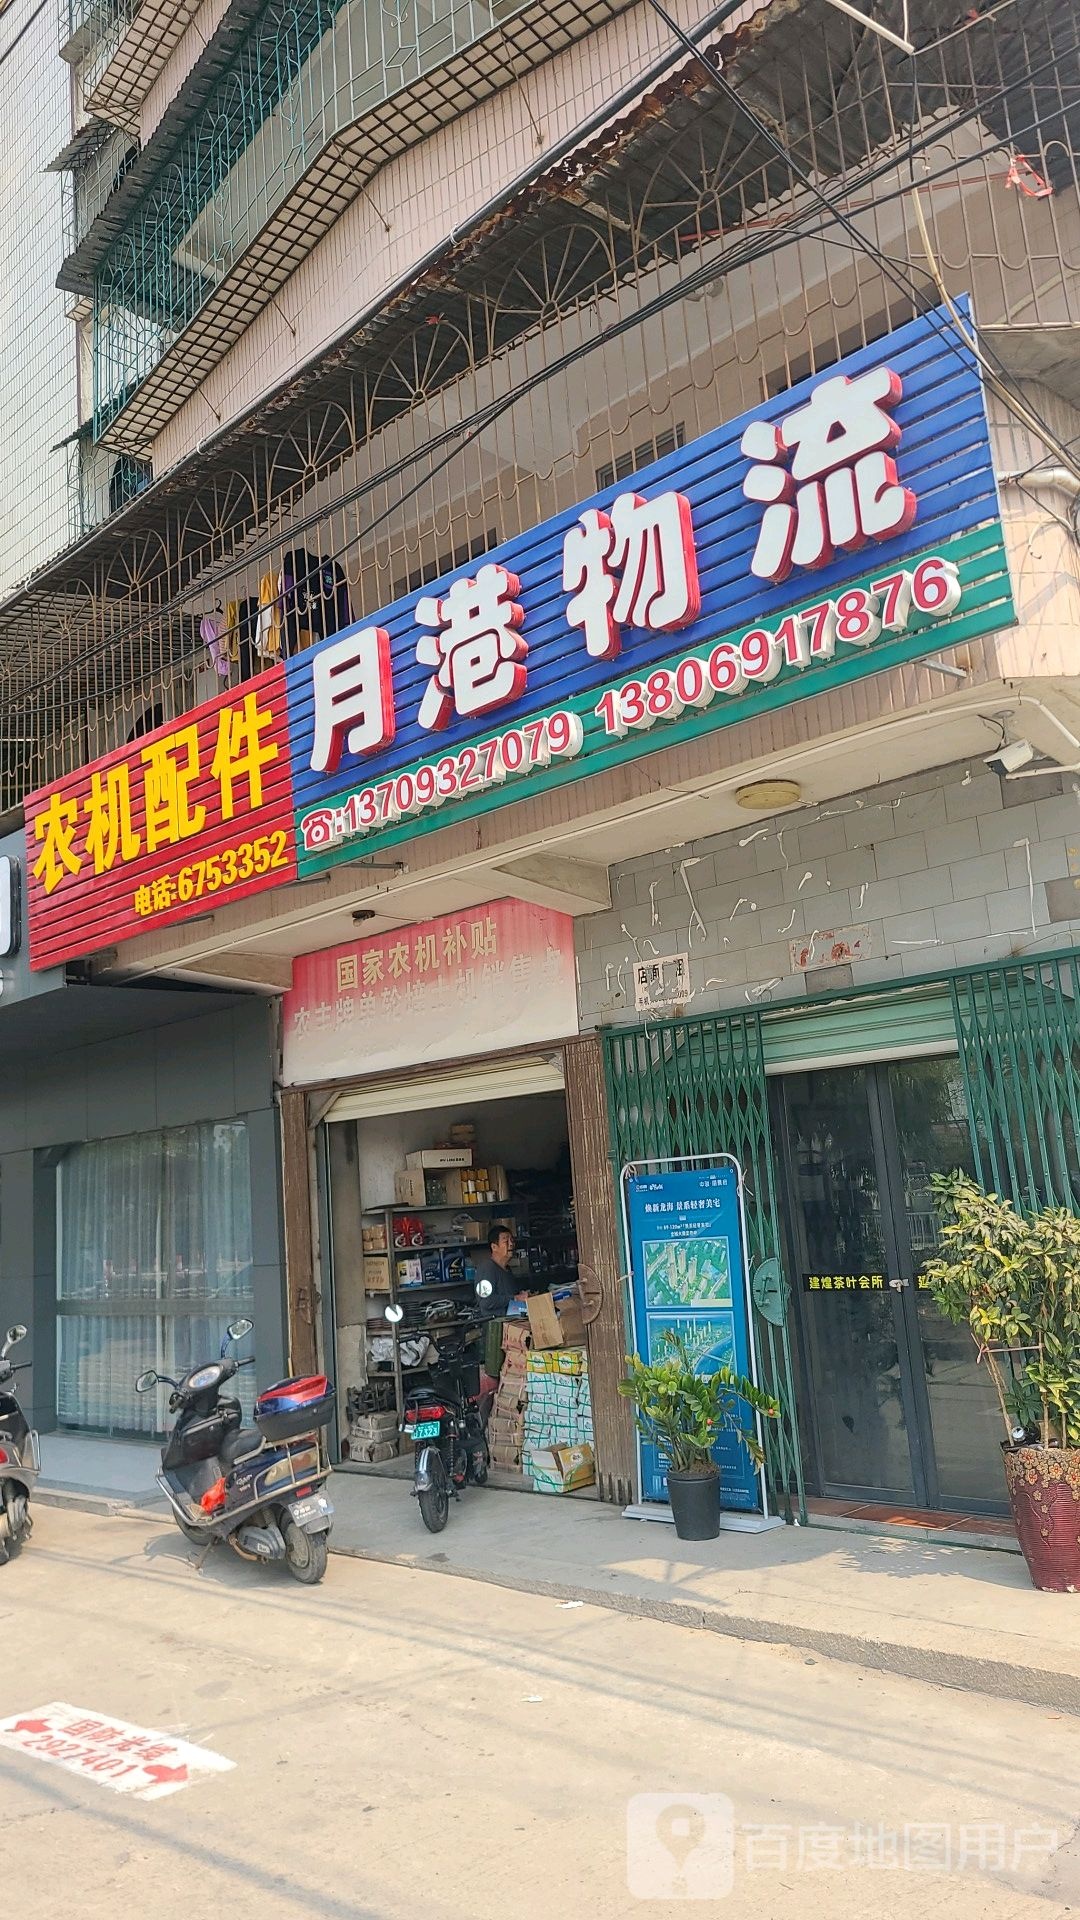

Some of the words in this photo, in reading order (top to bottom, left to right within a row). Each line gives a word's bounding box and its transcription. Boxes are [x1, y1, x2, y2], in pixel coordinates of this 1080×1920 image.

[309, 366, 917, 774] 月港物流
[594, 558, 961, 739] 13806917876
[32, 691, 279, 895] 农机配件
[134, 830, 288, 917] 电话:6753352
[336, 916, 498, 993] 国家农机补贴
[808, 1275, 883, 1290] 建煌茶叶会所
[21, 1734, 139, 1778] 2927401
